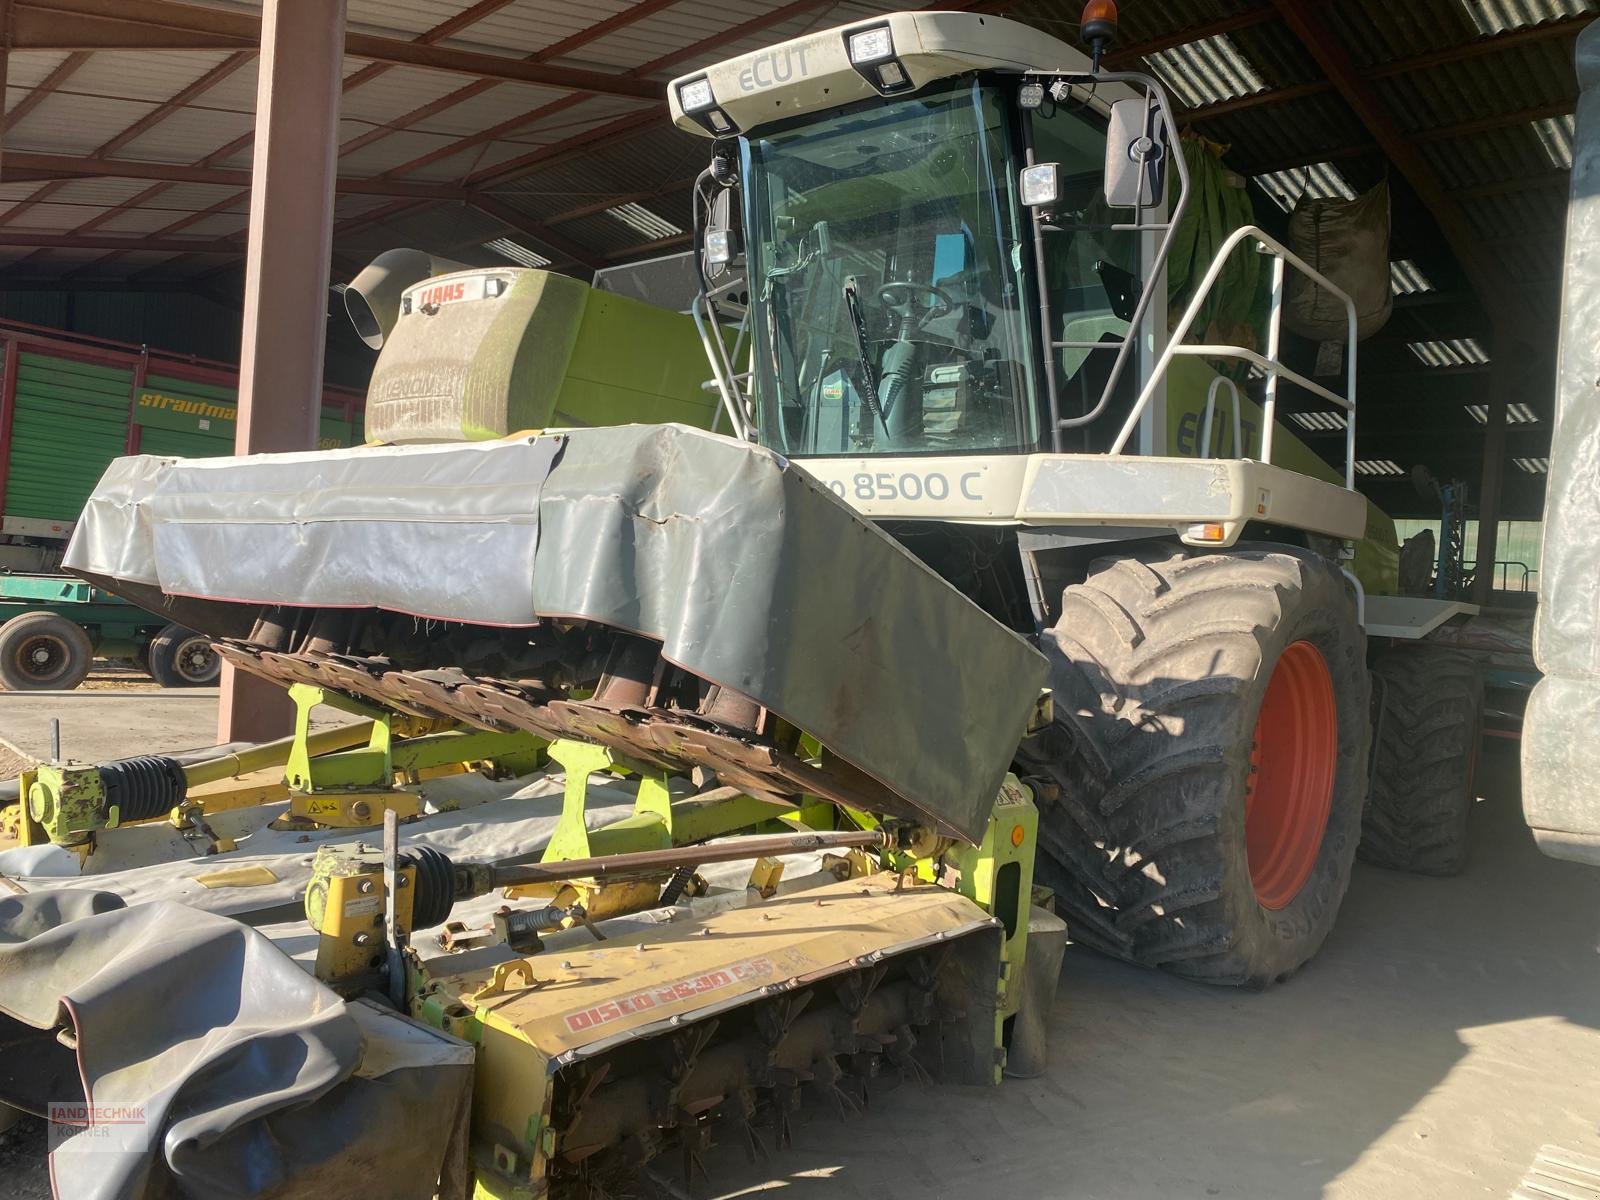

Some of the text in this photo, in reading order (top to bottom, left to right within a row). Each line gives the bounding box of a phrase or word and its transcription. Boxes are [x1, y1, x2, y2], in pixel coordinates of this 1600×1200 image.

[739, 44, 808, 91] eCUT
[139, 392, 238, 420] strautma
[854, 472, 949, 500] 8500
[960, 472, 983, 500] C
